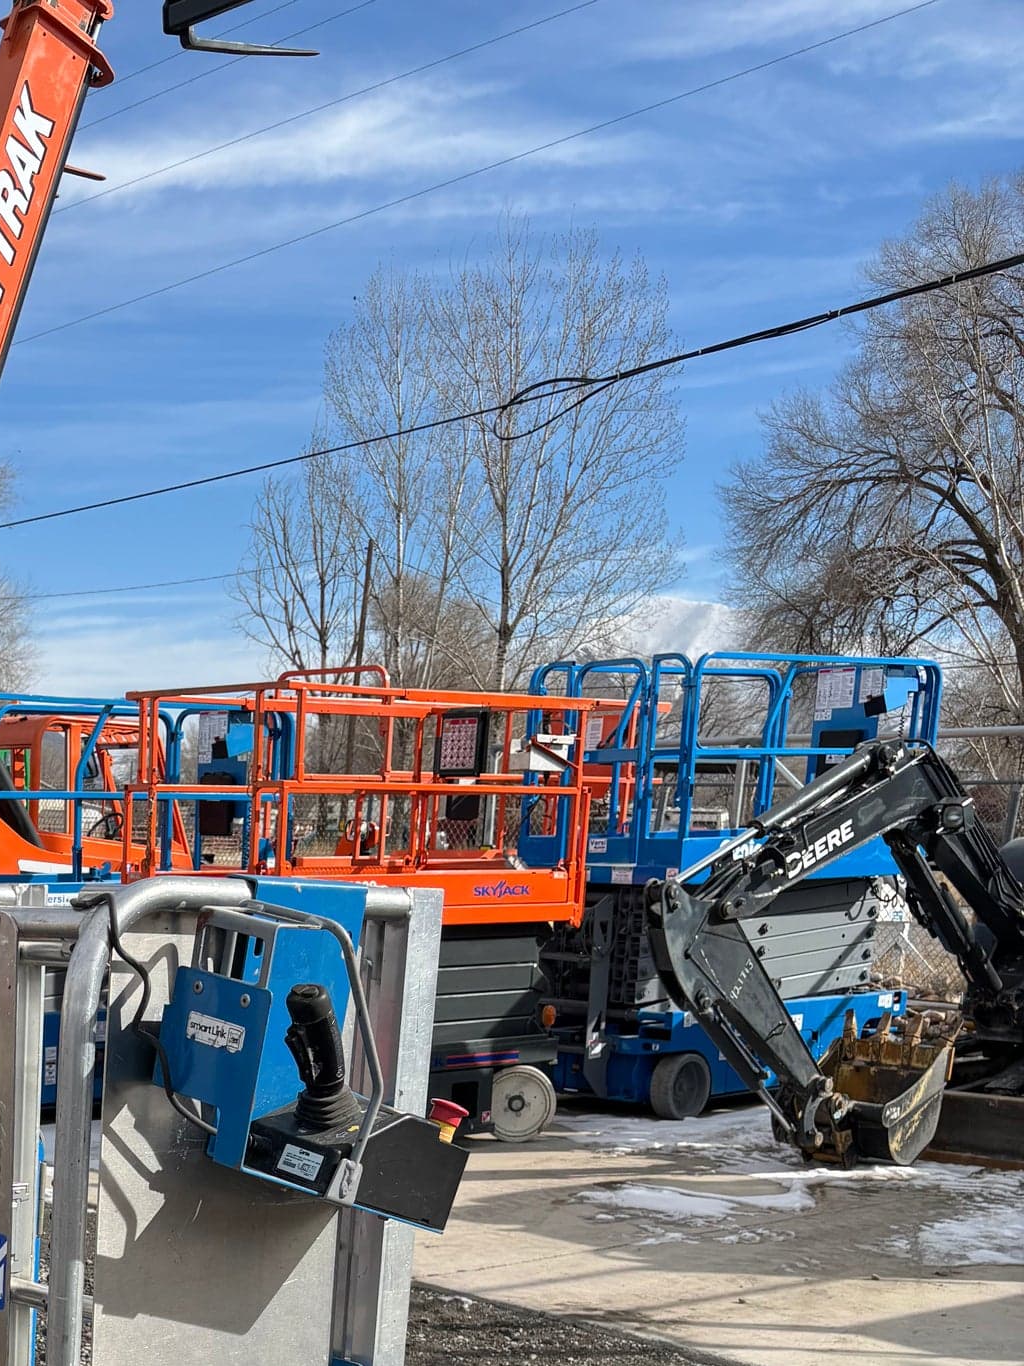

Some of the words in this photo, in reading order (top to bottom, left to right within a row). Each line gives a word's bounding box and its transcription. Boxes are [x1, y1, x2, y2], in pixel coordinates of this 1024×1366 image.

[785, 819, 855, 880] DEERE
[473, 880, 530, 898] SKYJACK
[48, 894, 65, 904] ersi
